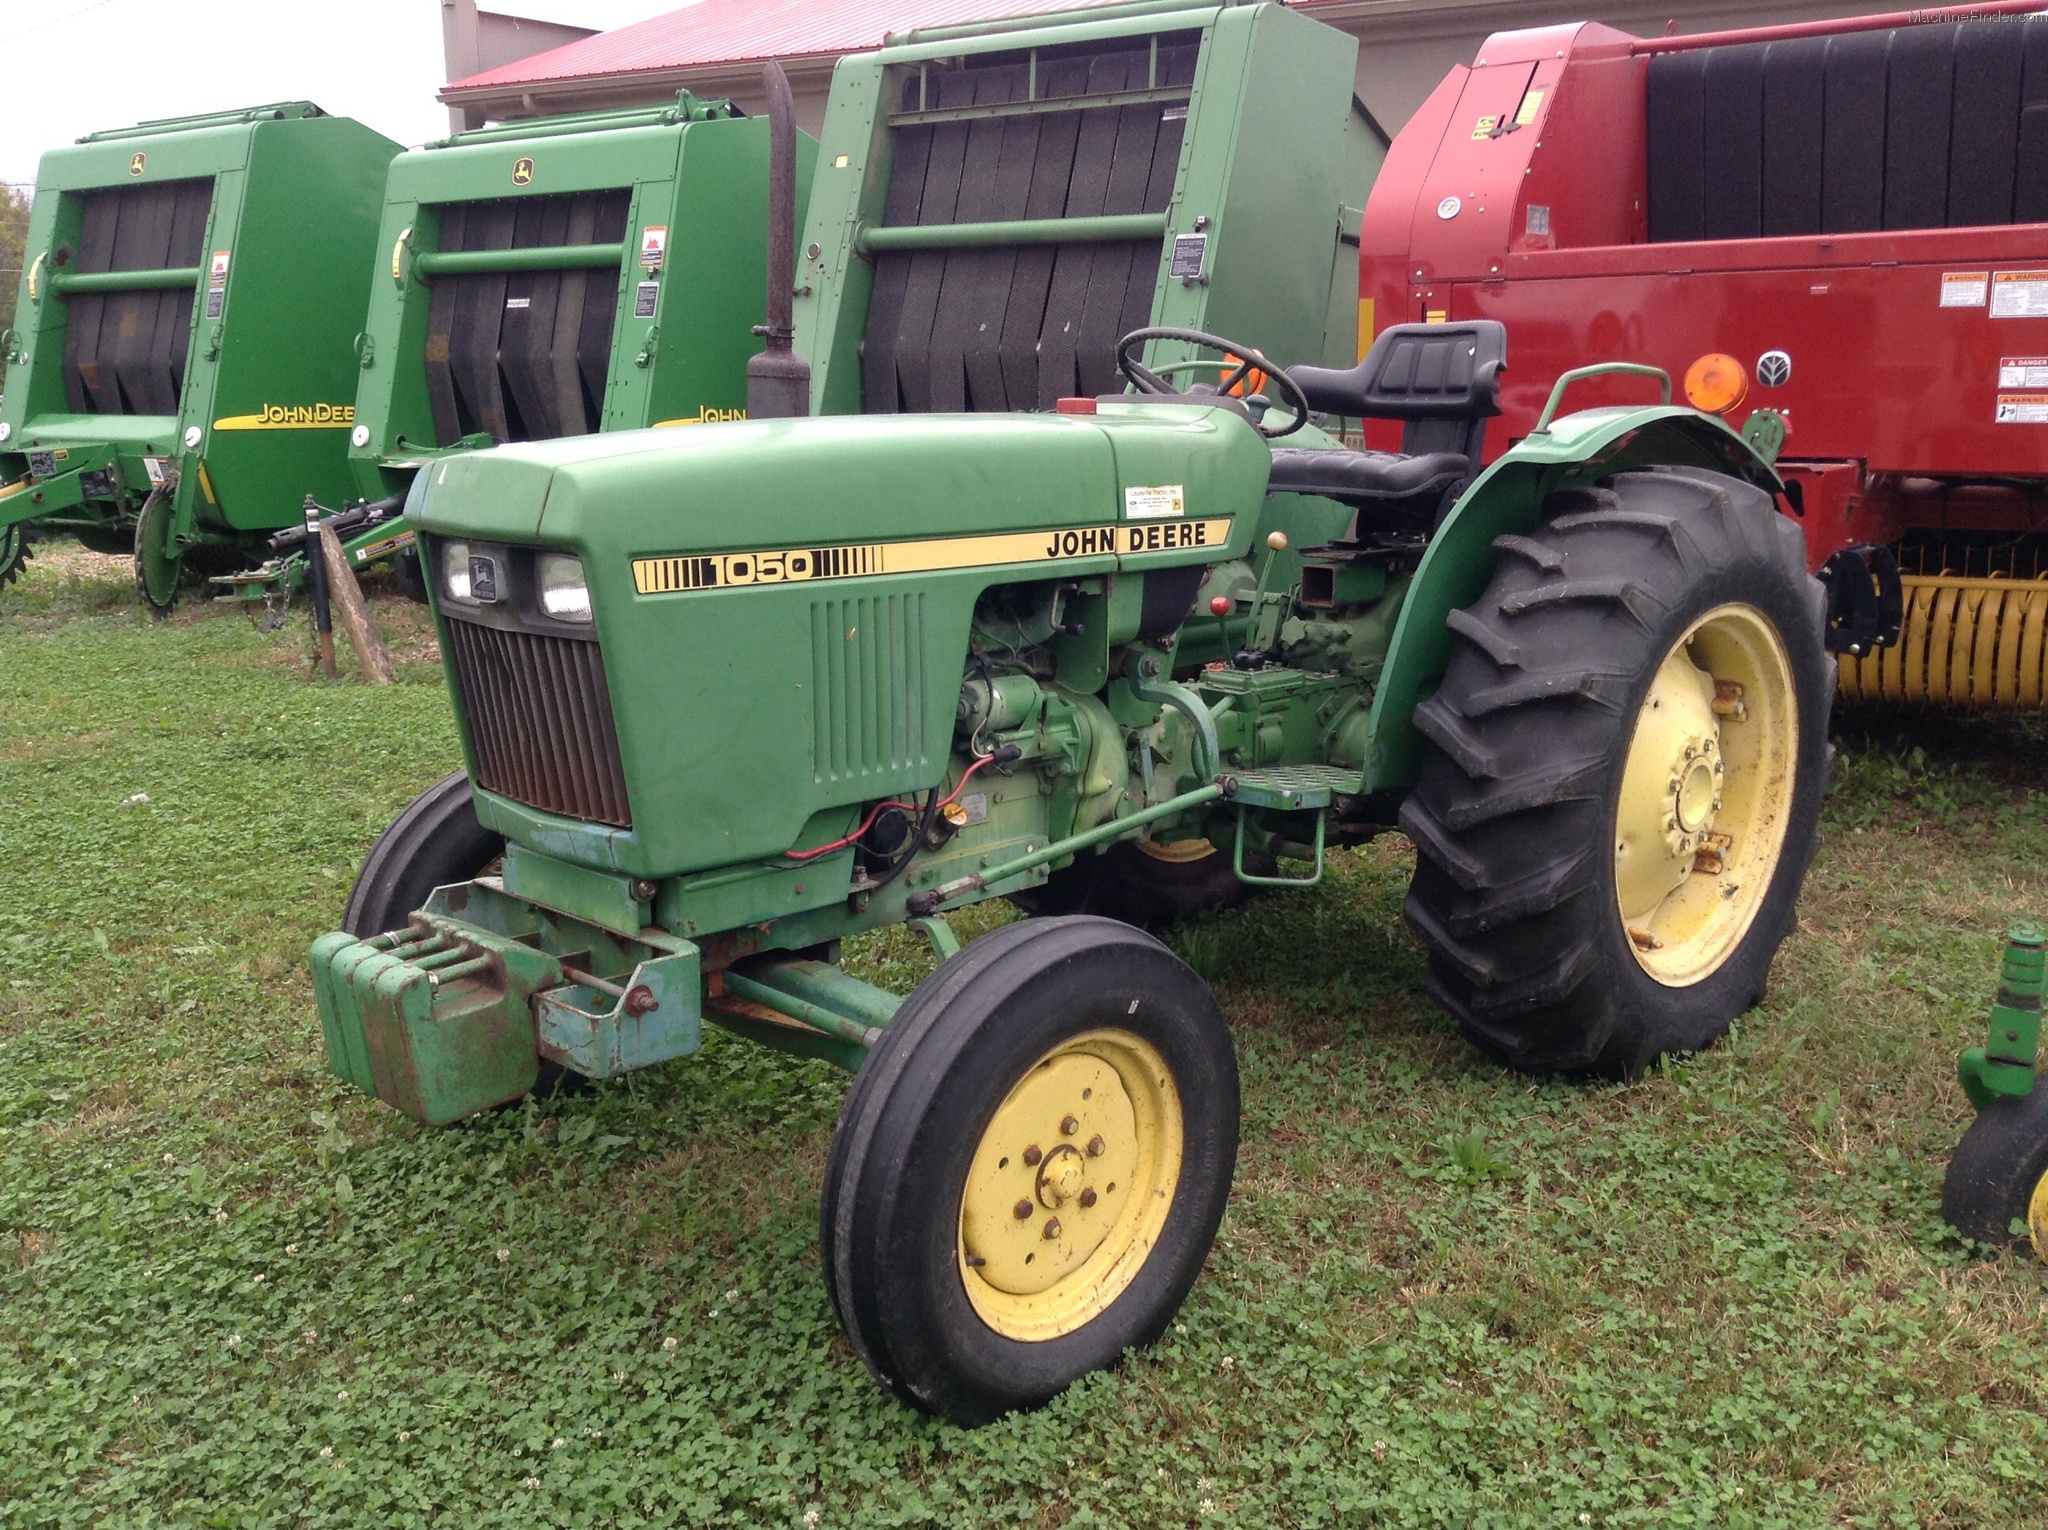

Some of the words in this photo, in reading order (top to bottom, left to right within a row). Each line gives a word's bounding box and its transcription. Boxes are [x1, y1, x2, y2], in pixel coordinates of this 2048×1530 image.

[257, 403, 312, 422] JOHN
[316, 403, 354, 421] DEE
[692, 404, 746, 423] JOHN
[1346, 437, 1364, 448] OHN
[1046, 528, 1115, 557] JOHN
[1130, 523, 1206, 551] DEERE
[710, 550, 814, 584] 1050
